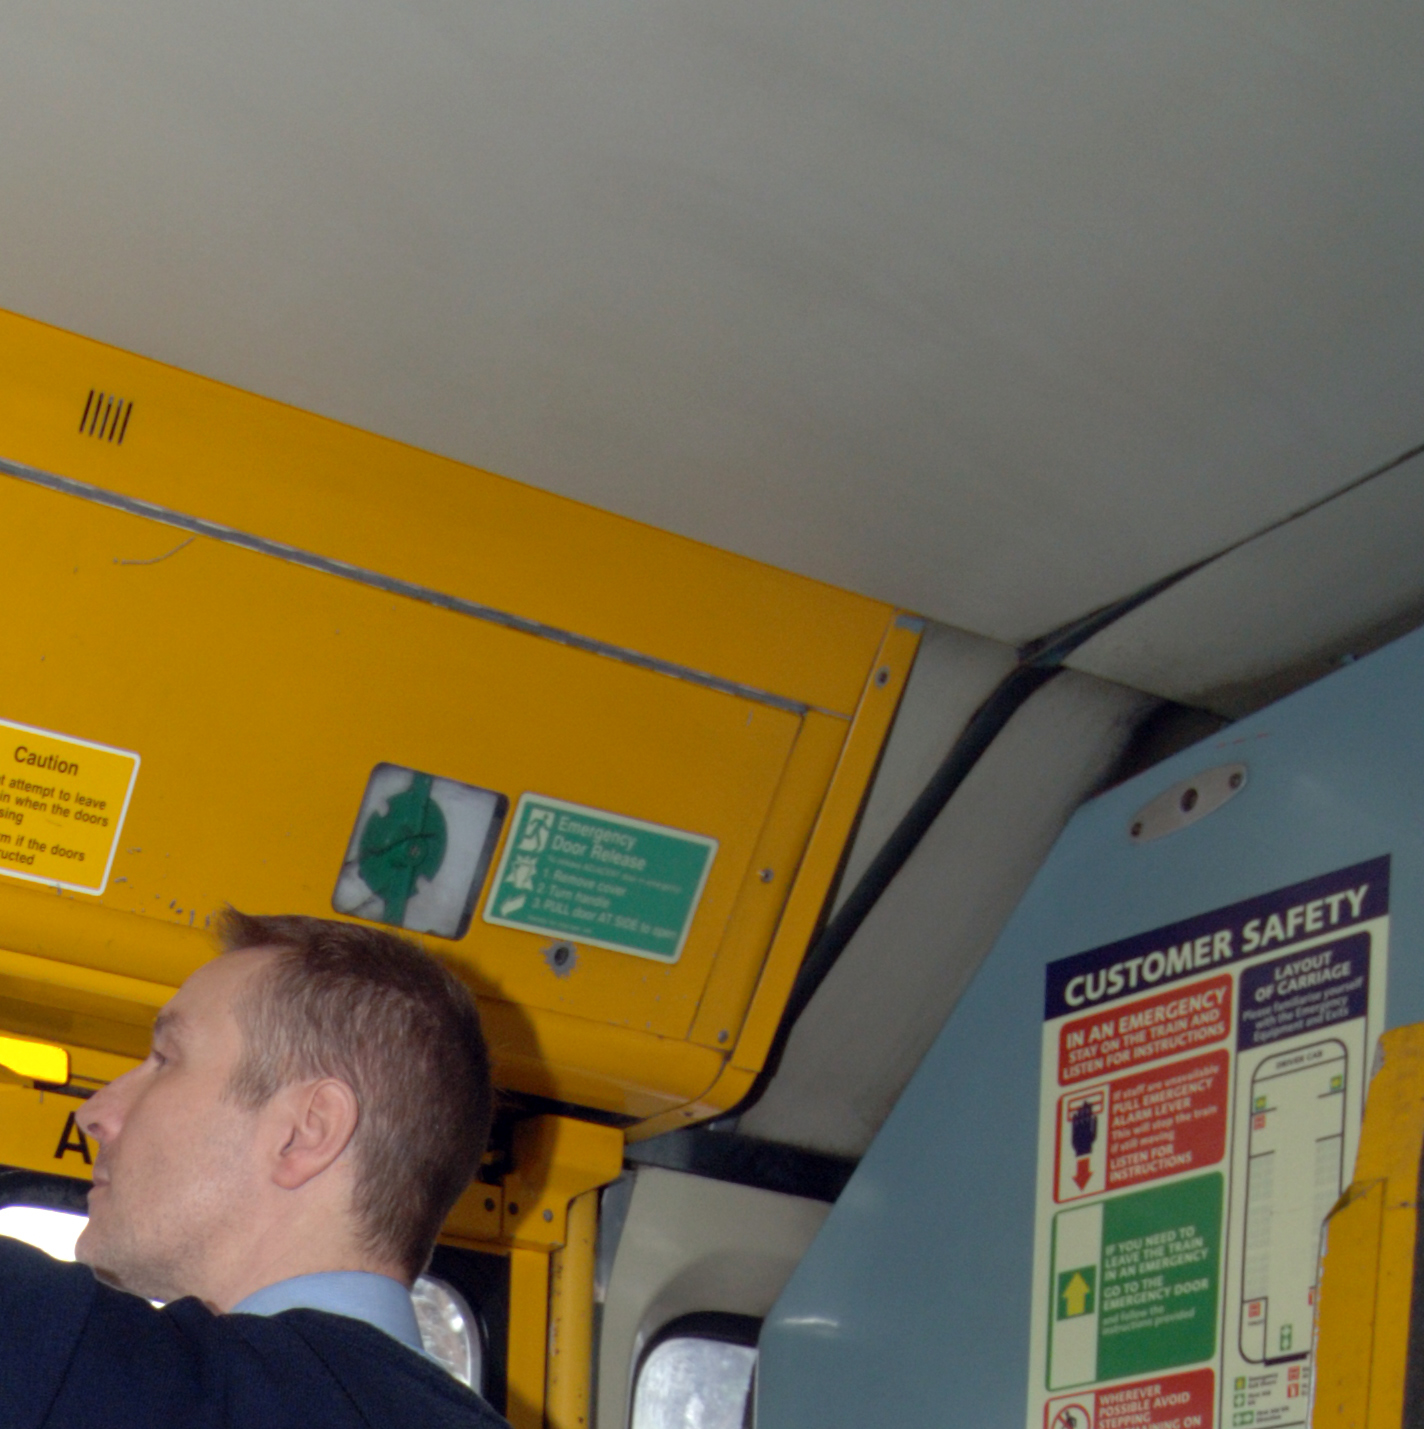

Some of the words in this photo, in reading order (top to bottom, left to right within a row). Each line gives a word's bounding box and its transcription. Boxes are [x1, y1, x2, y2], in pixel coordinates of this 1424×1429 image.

[14, 746, 78, 776] Caution
[9, 777, 55, 799] attempt
[59, 790, 71, 802] to
[75, 794, 106, 810] leave
[15, 795, 46, 812] when
[52, 804, 70, 817] the
[74, 809, 108, 827] doors
[16, 835, 24, 846] if
[28, 839, 46, 852] the
[51, 844, 85, 861] doors
[558, 816, 637, 850] Emergency
[552, 835, 587, 856] Door
[590, 844, 647, 871] Release
[553, 869, 595, 889] Remove
[597, 882, 626, 897] cover
[543, 899, 569, 916] PULL
[598, 912, 613, 924] AT
[1064, 930, 1232, 1007] CUSTOMER
[1242, 884, 1369, 952] SAFETY
[1274, 950, 1333, 980] LAYOUT
[1255, 984, 1274, 1002] OF
[1277, 961, 1351, 995] CARRIAGE
[1067, 1030, 1085, 1049] IN
[1088, 1021, 1114, 1042] AN
[1119, 986, 1227, 1034] EMERGENCY
[1063, 1057, 1103, 1080] LISTEN
[1106, 1051, 1130, 1068] FOR
[1134, 1021, 1225, 1059] INSTRUCTIONS
[1069, 1045, 1098, 1064] STAY
[1100, 1038, 1119, 1053] ON
[1124, 1030, 1147, 1047] THE
[1150, 1018, 1188, 1040] TRAIN
[1190, 1008, 1220, 1028] AND
[1147, 1081, 1163, 1092] are
[1164, 1064, 1219, 1086] unavailable
[1112, 1099, 1139, 1114] PULL
[1142, 1078, 1214, 1106] EMERGENCY
[1112, 1108, 1152, 1127] ALARM
[1154, 1096, 1191, 1116] LEVER
[1110, 1151, 1148, 1170] LISTEN
[1151, 1144, 1173, 1158] FOR
[1110, 1151, 1192, 1182] INSTRUCTIONS
[1105, 1244, 1116, 1256] IF
[1118, 1239, 1143, 1253] YOU
[1145, 1230, 1176, 1246] NEED
[1178, 1226, 1195, 1239] TO
[1105, 1252, 1139, 1269] LEAVE
[1143, 1245, 1165, 1260] THE
[1168, 1236, 1203, 1254] TRAIN
[1104, 1270, 1116, 1281] IN
[1119, 1266, 1136, 1278] AN
[1139, 1248, 1208, 1274] EMERGENCY
[1103, 1285, 1121, 1298] GO
[1123, 1281, 1139, 1293] TO
[1142, 1276, 1164, 1290] THE
[1104, 1286, 1172, 1311] EMERGENCY
[1174, 1278, 1209, 1296] DOOR
[1099, 1384, 1161, 1405] WHEREVER
[1099, 1399, 1150, 1417] POSSIBLE
[1153, 1391, 1190, 1408] AVOID
[1099, 1412, 1151, 1429] STEPPING
[1183, 1415, 1201, 1428] ON
